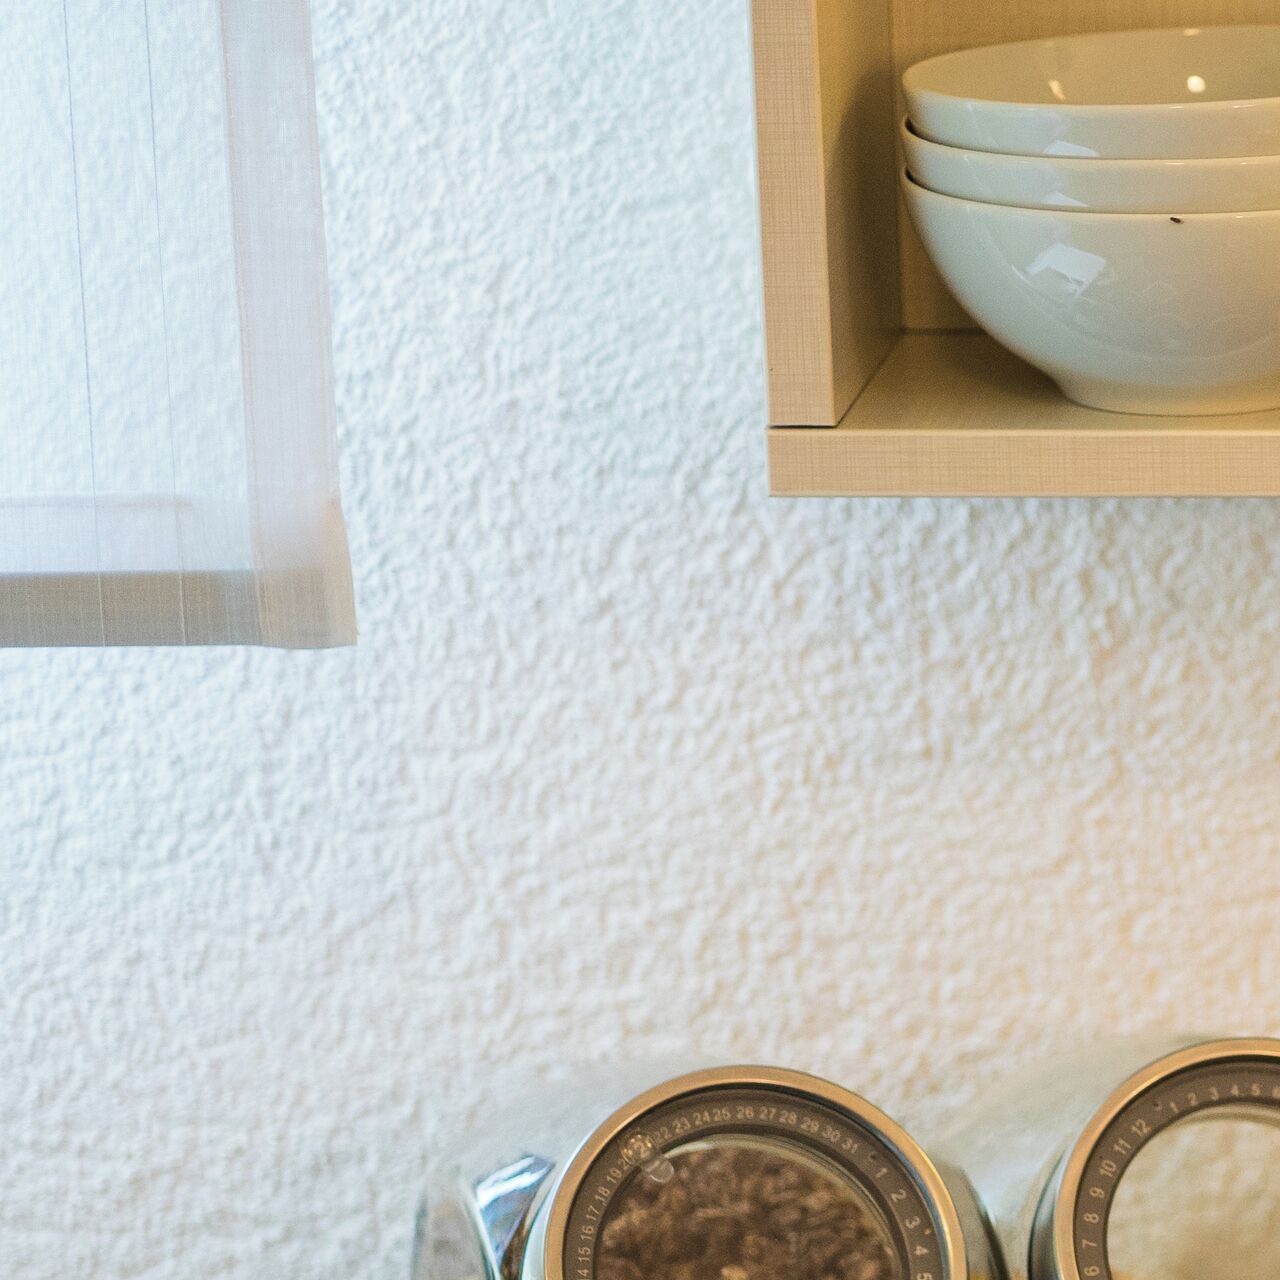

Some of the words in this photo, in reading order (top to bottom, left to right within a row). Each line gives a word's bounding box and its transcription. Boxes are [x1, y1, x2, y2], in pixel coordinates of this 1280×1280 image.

[1169, 1101, 1179, 1114] 1
[1187, 1092, 1199, 1106] 2
[1209, 1086, 1220, 1100] 3
[1251, 1083, 1261, 1096] 5
[693, 1110, 711, 1126] 24
[712, 1107, 732, 1122] 25
[736, 1106, 755, 1120] 26
[758, 1106, 777, 1120] 27
[778, 1110, 798, 1125] 28
[672, 1117, 692, 1134] 23
[799, 1117, 820, 1133] 29
[1131, 1118, 1151, 1137] 12
[1113, 1138, 1132, 1155] 11
[606, 1167, 623, 1184] 19
[1099, 1159, 1117, 1178] 10
[594, 1187, 611, 1203] 18
[1089, 1186, 1105, 1199] 9
[585, 1204, 600, 1221] 17
[875, 1167, 888, 1179] 1
[890, 1189, 907, 1203] 2
[905, 1216, 921, 1229] 3
[914, 1245, 929, 1256] 4
[1083, 1212, 1100, 1224] 8
[580, 1225, 595, 1240] 16
[1081, 1239, 1098, 1249] 7
[577, 1246, 592, 1262] 15
[1083, 1265, 1101, 1277] 6
